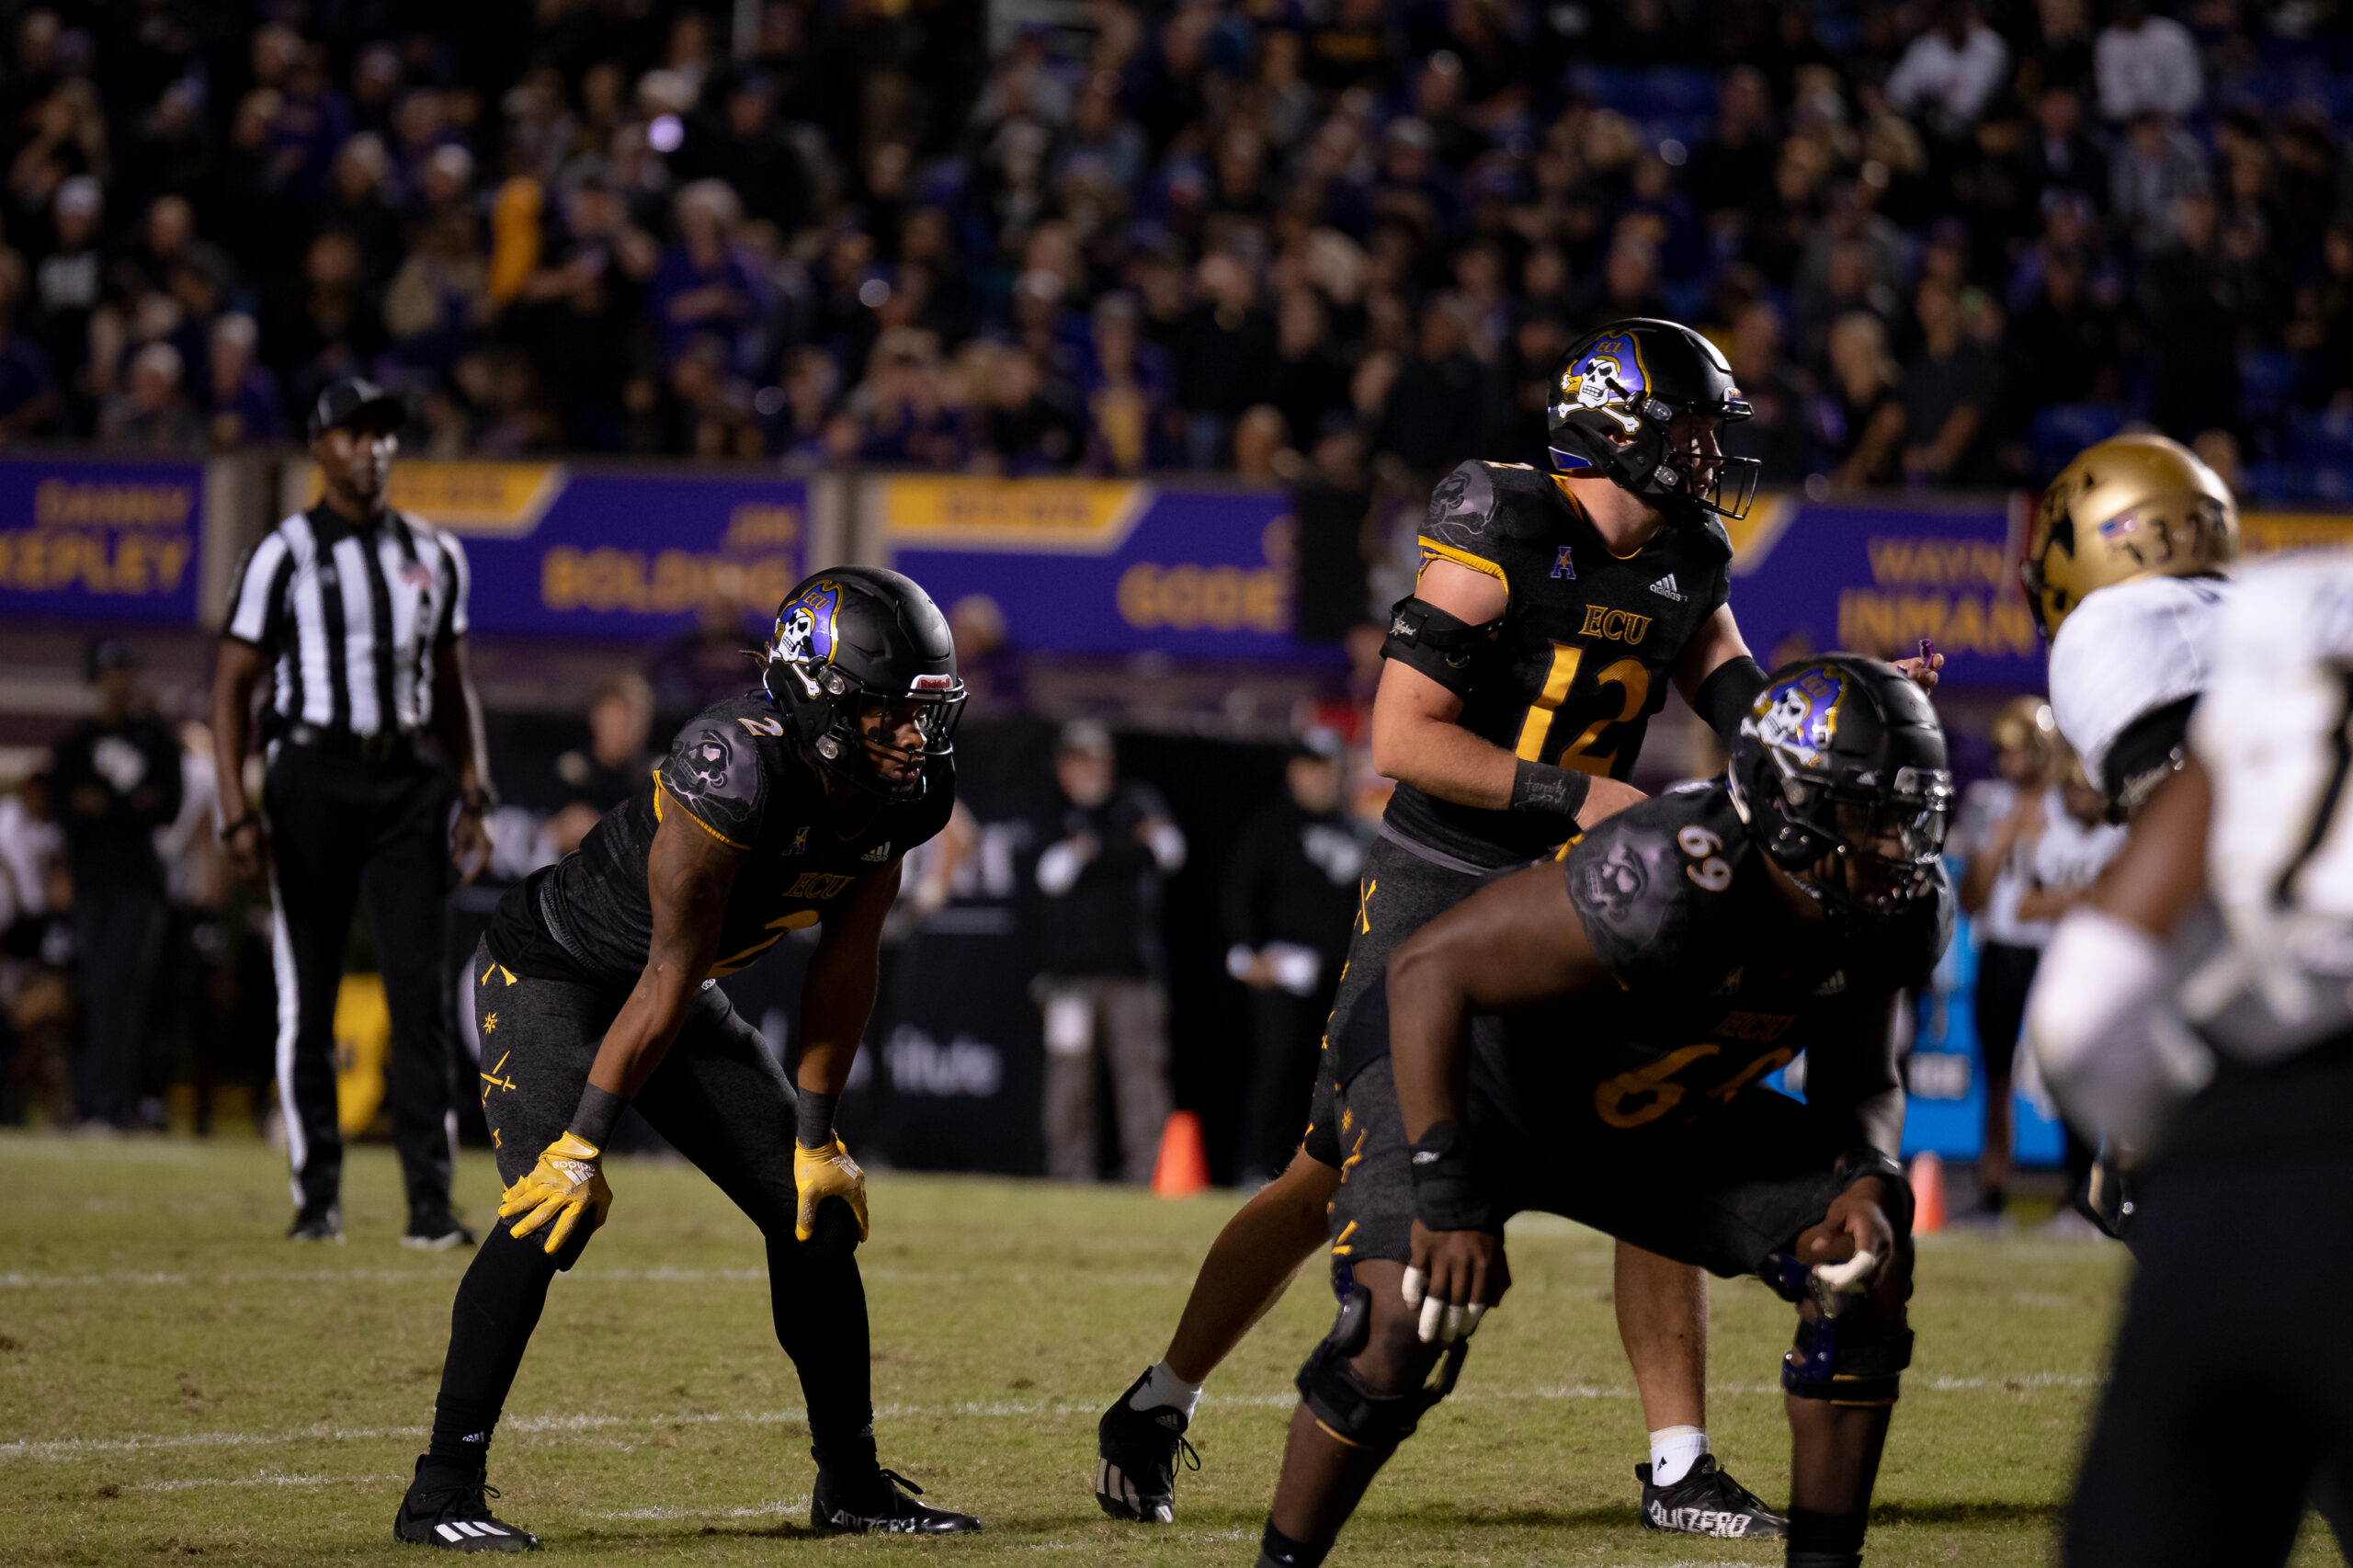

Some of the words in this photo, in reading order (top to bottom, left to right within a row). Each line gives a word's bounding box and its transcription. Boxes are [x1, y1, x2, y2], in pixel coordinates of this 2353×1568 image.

[1595, 341, 1625, 354] ECU
[802, 591, 832, 610] ECU
[1649, 583, 1682, 603] adidas
[1577, 603, 1653, 645] ECU
[1513, 641, 1652, 779] 12
[737, 716, 784, 737] 2
[1677, 824, 1734, 892] 69
[781, 872, 856, 900] ECU
[551, 1160, 596, 1172] adidas
